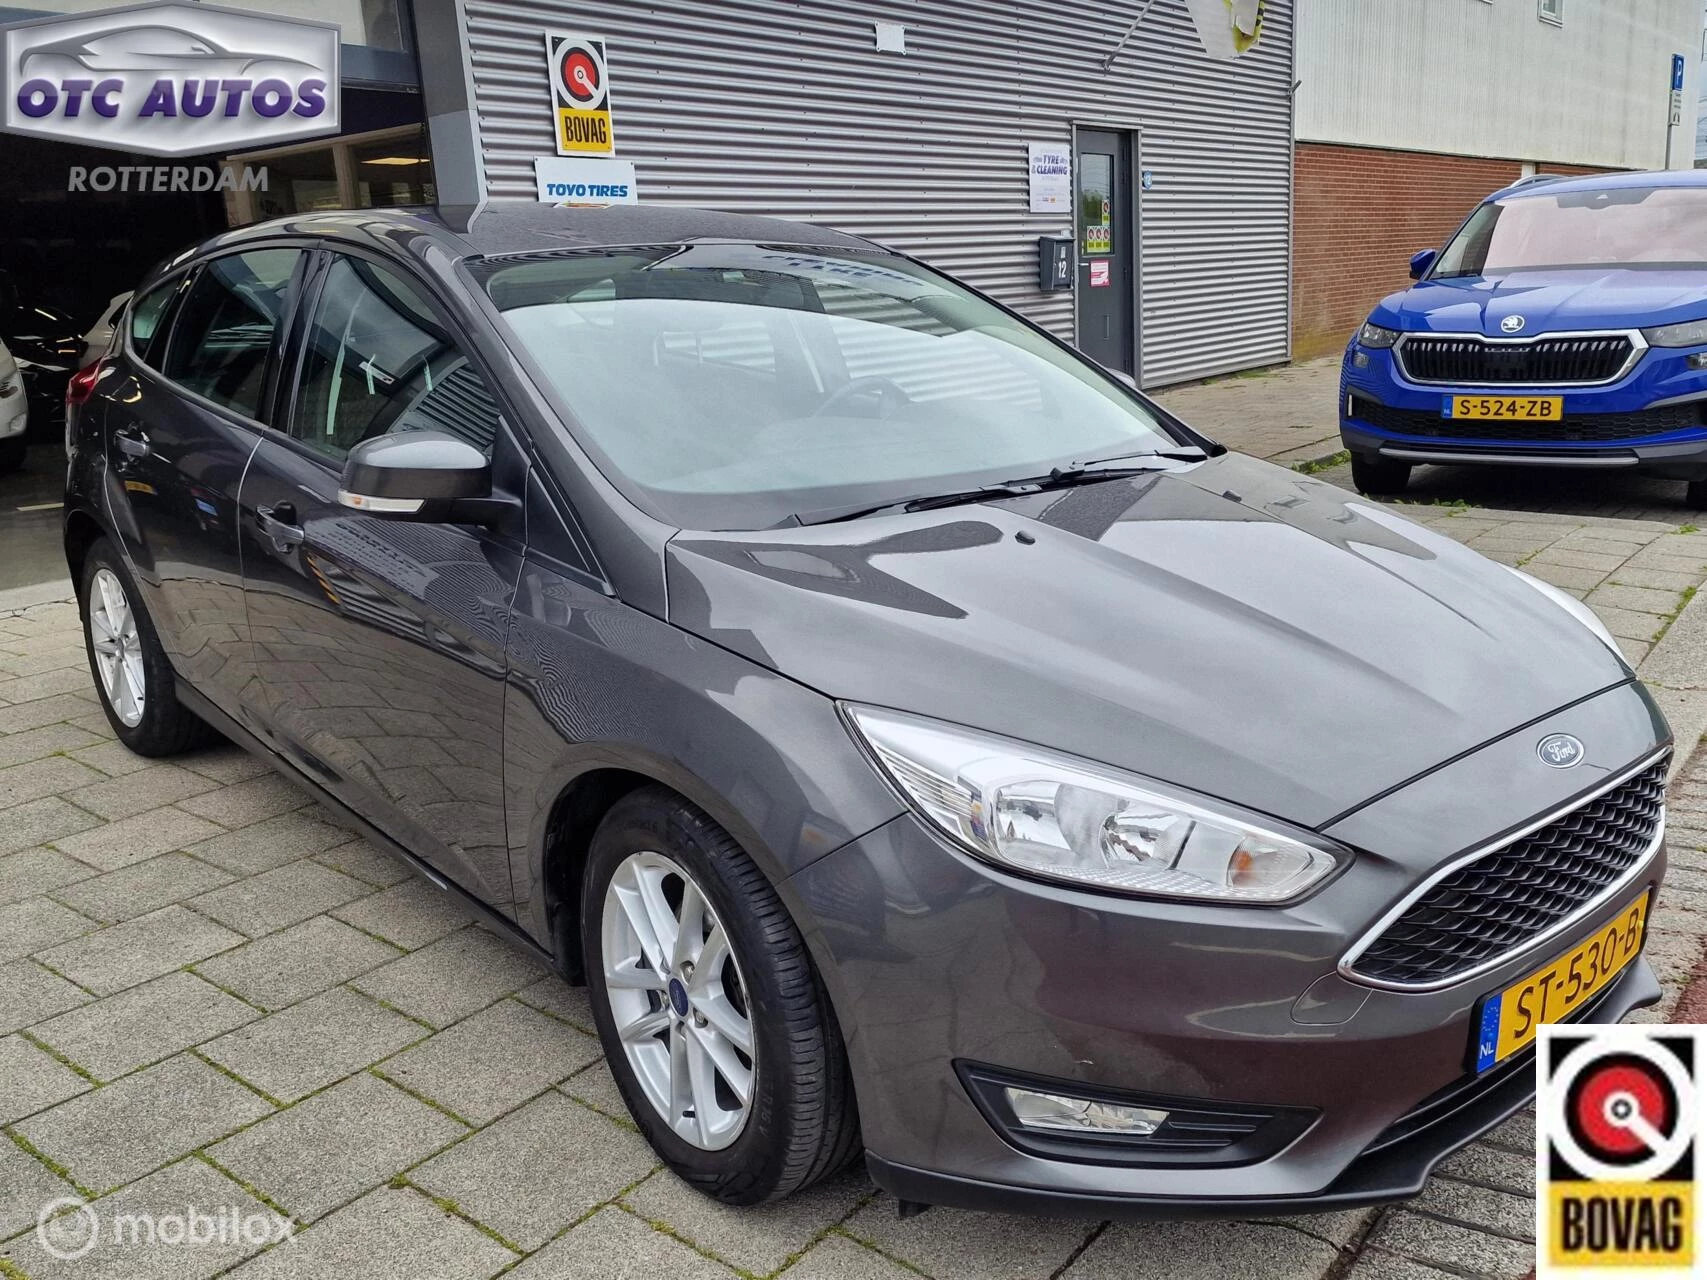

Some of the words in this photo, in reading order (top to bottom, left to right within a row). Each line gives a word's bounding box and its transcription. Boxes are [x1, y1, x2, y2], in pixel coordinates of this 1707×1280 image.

[564, 115, 607, 144] BOVAG
[1043, 154, 1060, 165] TYRE
[1036, 165, 1068, 175] CLEANING
[546, 183, 587, 196] TOYO
[588, 184, 628, 197] TIRES
[1058, 260, 1067, 278] 12
[1459, 399, 1552, 417] S-524-ZB
[1513, 906, 1640, 1039] ST-530-B
[1479, 1043, 1494, 1059] NL
